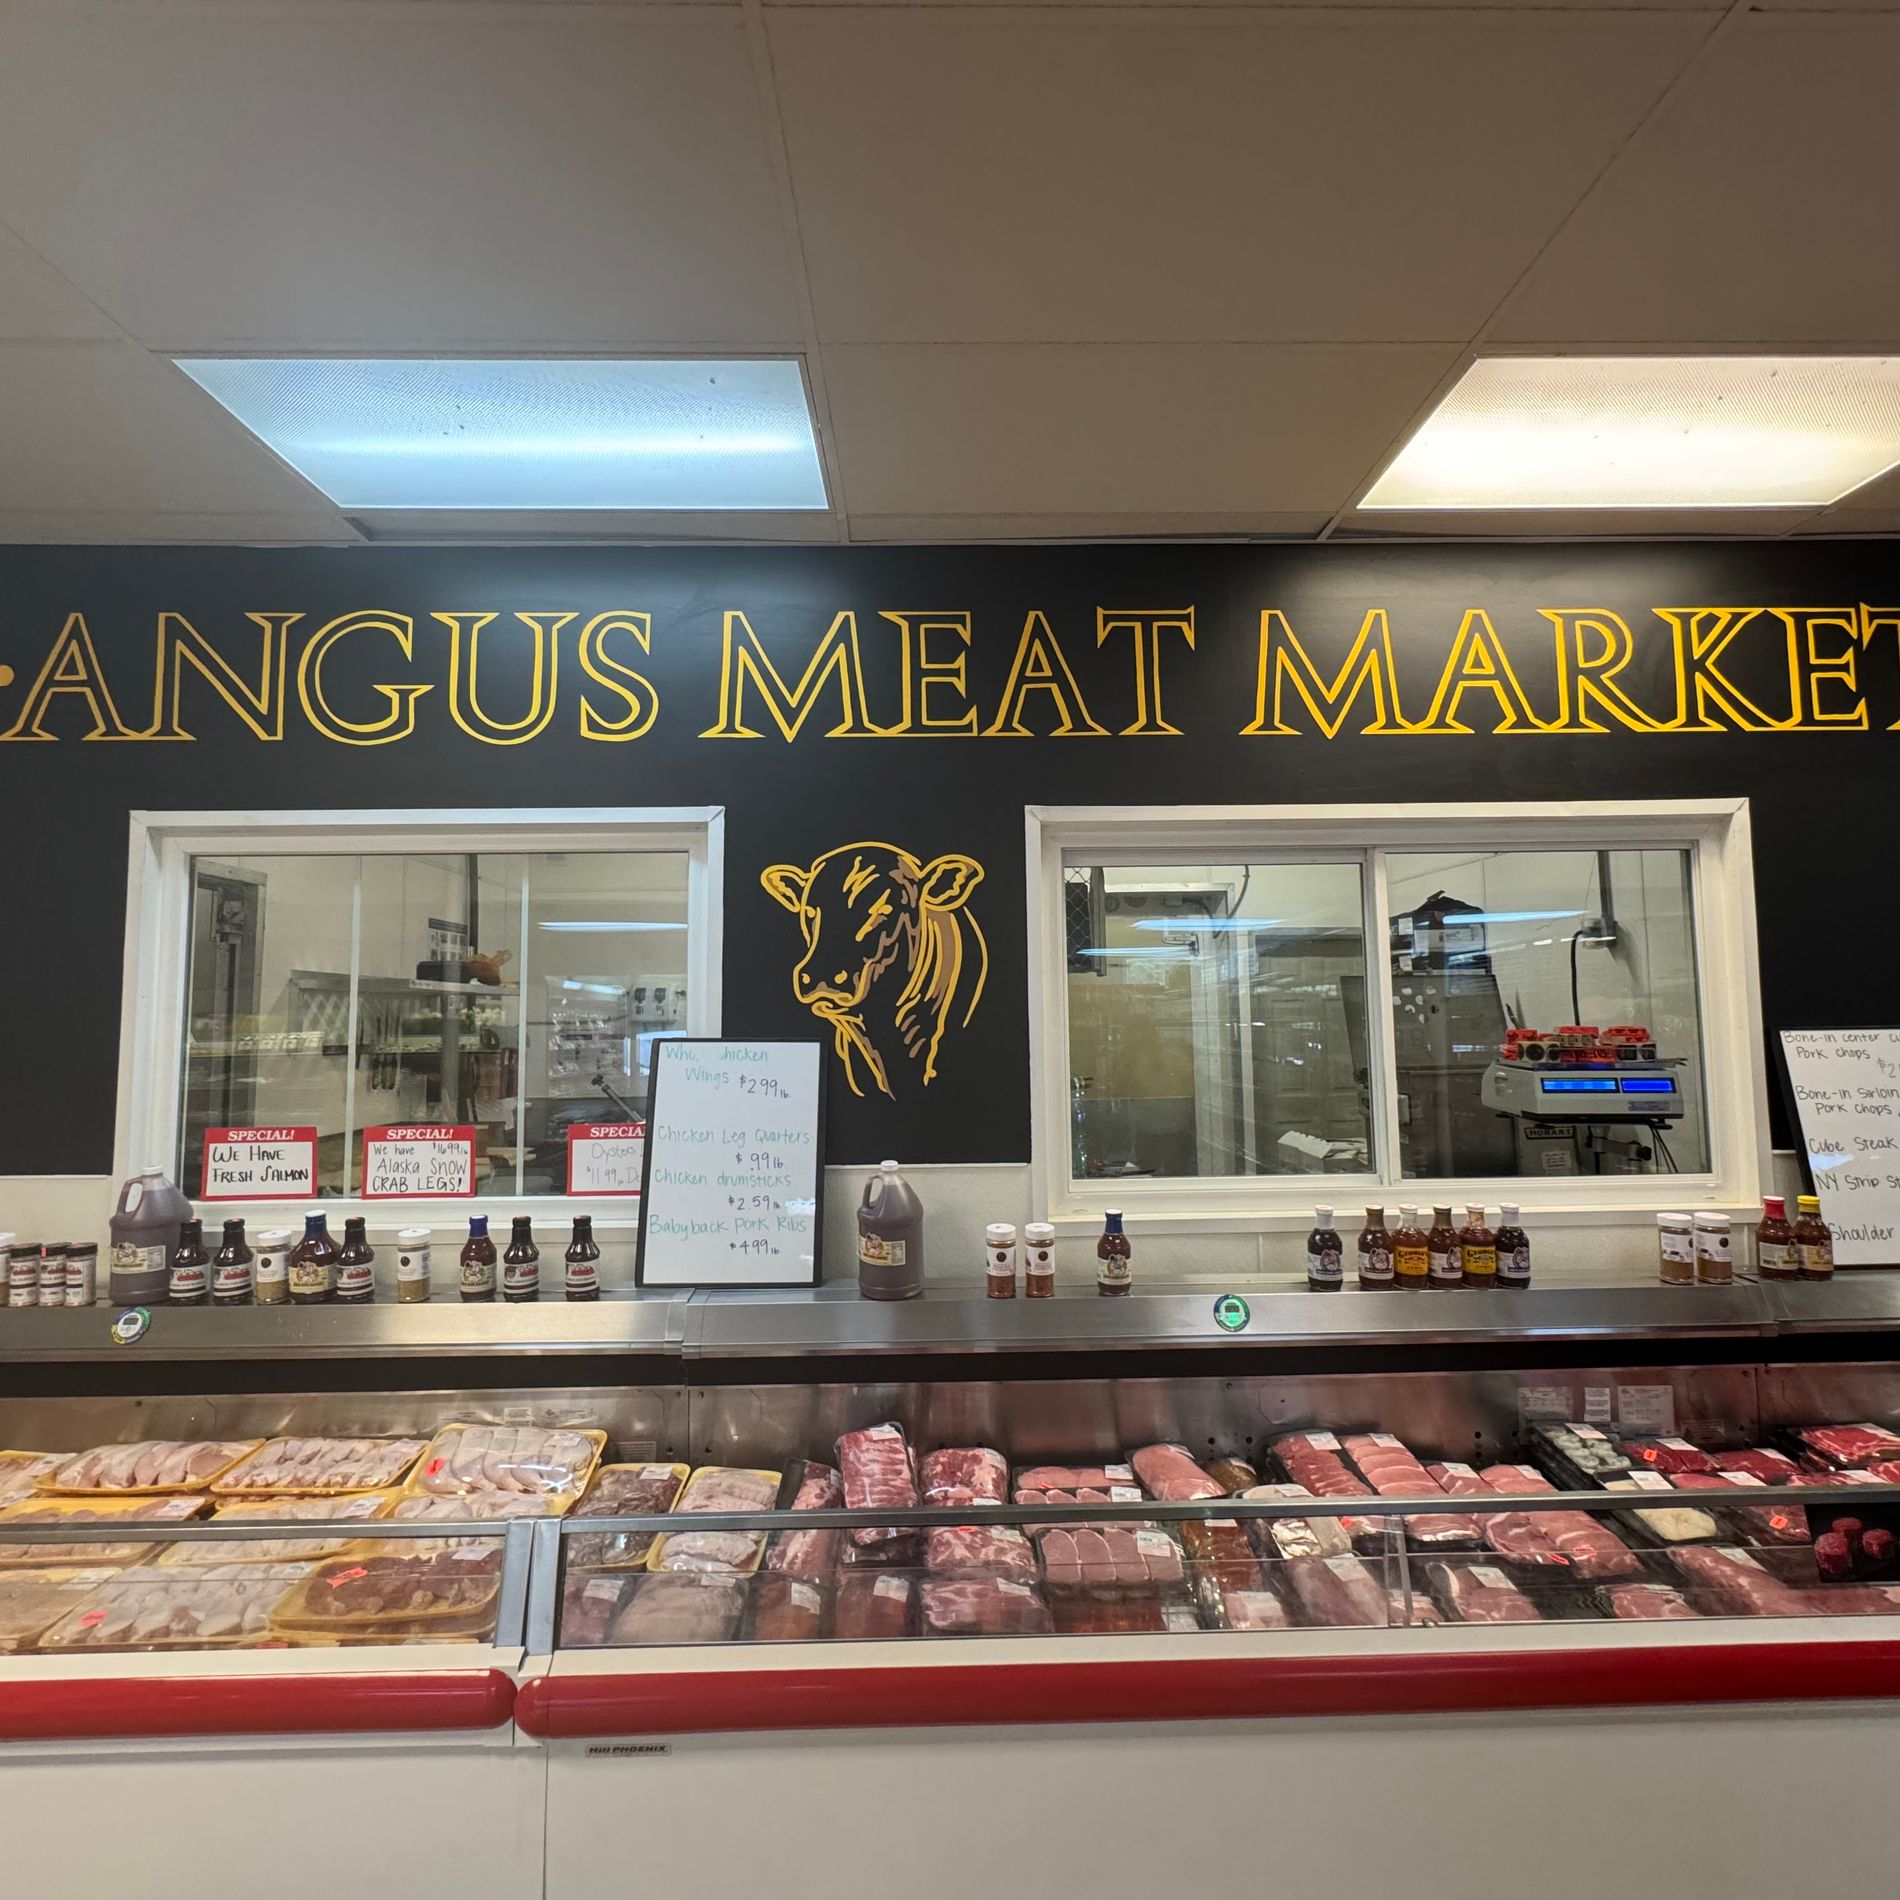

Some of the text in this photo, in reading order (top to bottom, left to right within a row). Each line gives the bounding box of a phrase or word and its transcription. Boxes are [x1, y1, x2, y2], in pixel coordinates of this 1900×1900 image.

[0, 610, 660, 746] ANGUS
[697, 604, 1196, 743] MEAT
[1783, 1030, 1838, 1044] Bone-in
[721, 1046, 769, 1063] hicken
[1796, 1045, 1829, 1059] Pork
[1877, 1056, 1900, 1079] $2
[684, 1066, 730, 1090] Wings
[1795, 1084, 1853, 1101] Bone-in
[1815, 1102, 1849, 1116] Pork
[228, 1129, 295, 1141] SPECIAL!
[386, 1128, 454, 1140] SPECIAL!
[657, 1125, 811, 1149] Chicken Leg Quarters
[1528, 1128, 1572, 1137] HOBART
[372, 1143, 388, 1155] We
[395, 1144, 415, 1155] have
[1808, 1135, 1899, 1154] Cube Steak
[213, 1165, 309, 1183] FRESH SALMON
[376, 1158, 421, 1176] Alaska
[372, 1175, 463, 1193] CRAB LEGS!
[655, 1168, 792, 1188] Chicken drumsticks
[1815, 1172, 1839, 1192] NY
[1844, 1174, 1880, 1191] Strip
[735, 1216, 770, 1234] Pork
[777, 1214, 807, 1232] Ribs
[1827, 1222, 1895, 1242] Shoulder
